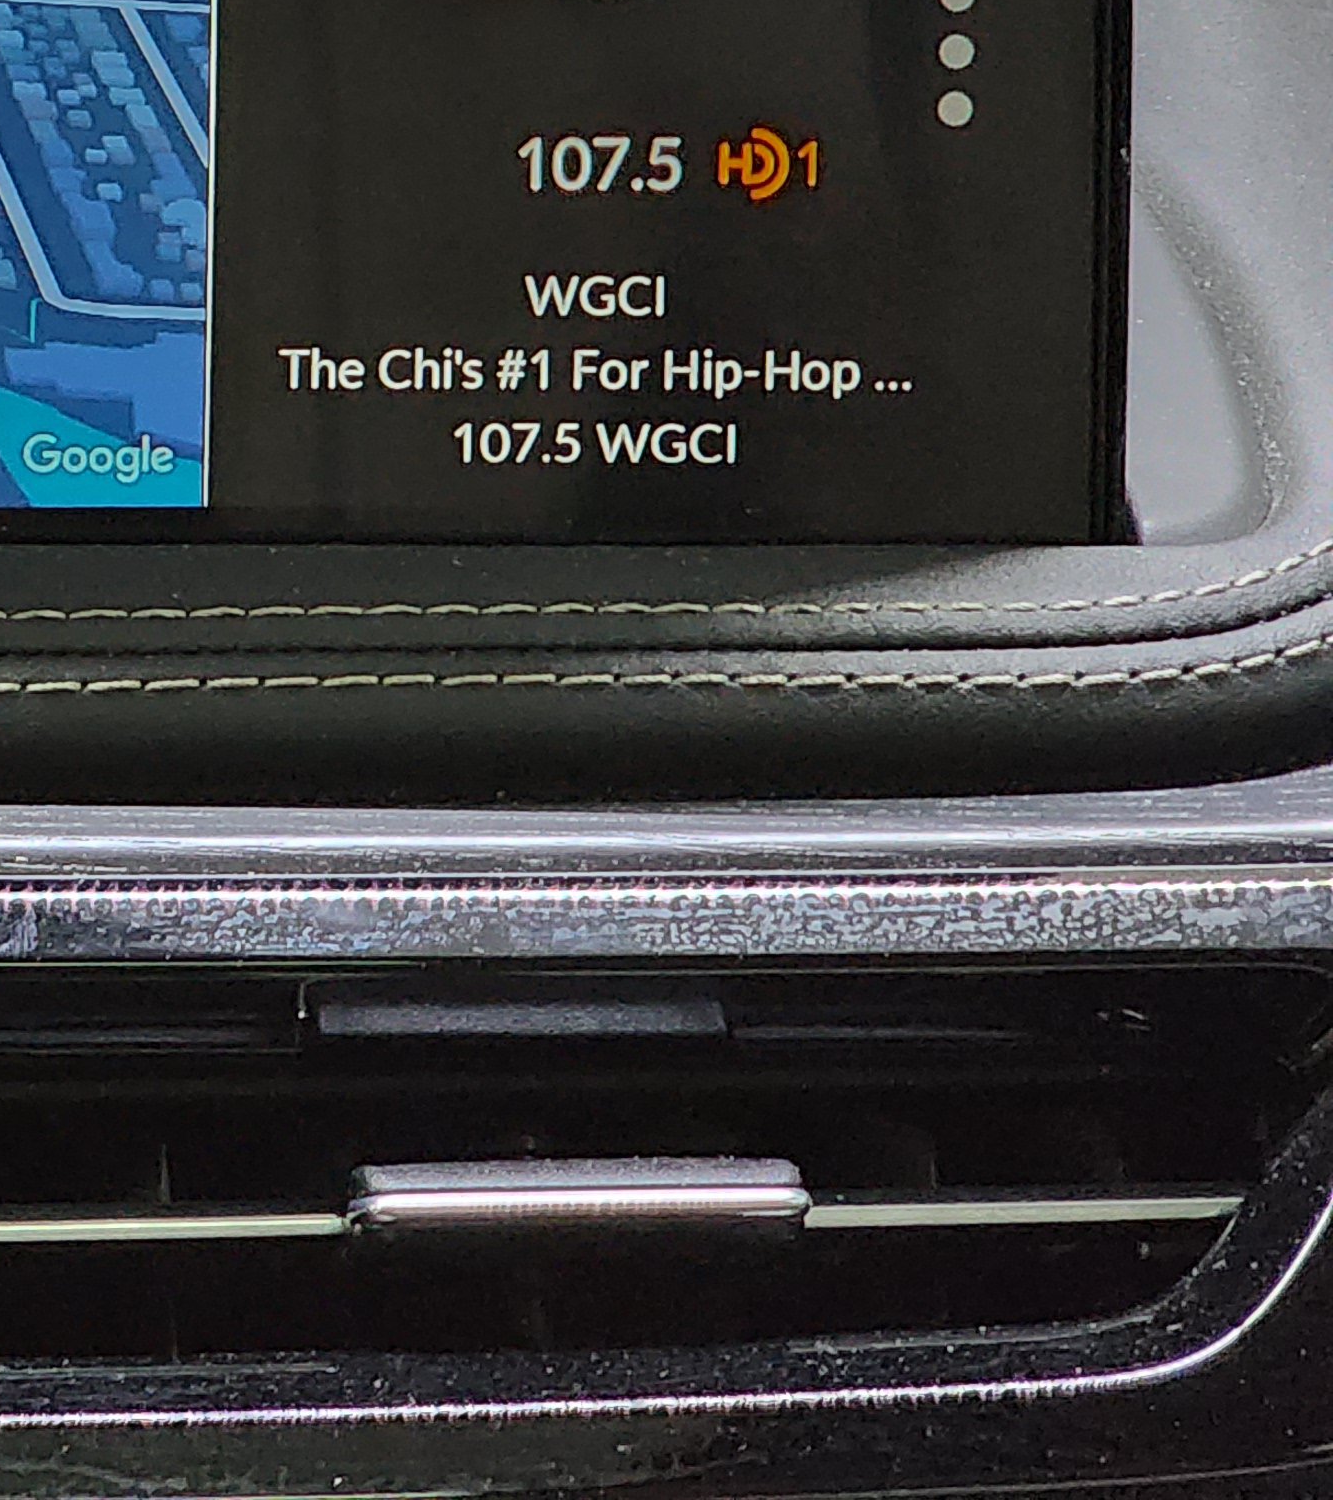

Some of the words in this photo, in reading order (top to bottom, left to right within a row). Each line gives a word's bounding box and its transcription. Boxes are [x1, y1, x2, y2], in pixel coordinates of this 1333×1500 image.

[517, 135, 686, 194] 107.5
[524, 274, 668, 318] WGCI
[278, 348, 366, 391] The
[377, 348, 484, 391] Chi's
[495, 348, 551, 391] #1
[572, 349, 651, 391] For
[663, 349, 862, 399] Hip-Hop
[21, 433, 175, 484] Google
[453, 422, 583, 465] 107.5
[595, 422, 738, 465] WGCI
